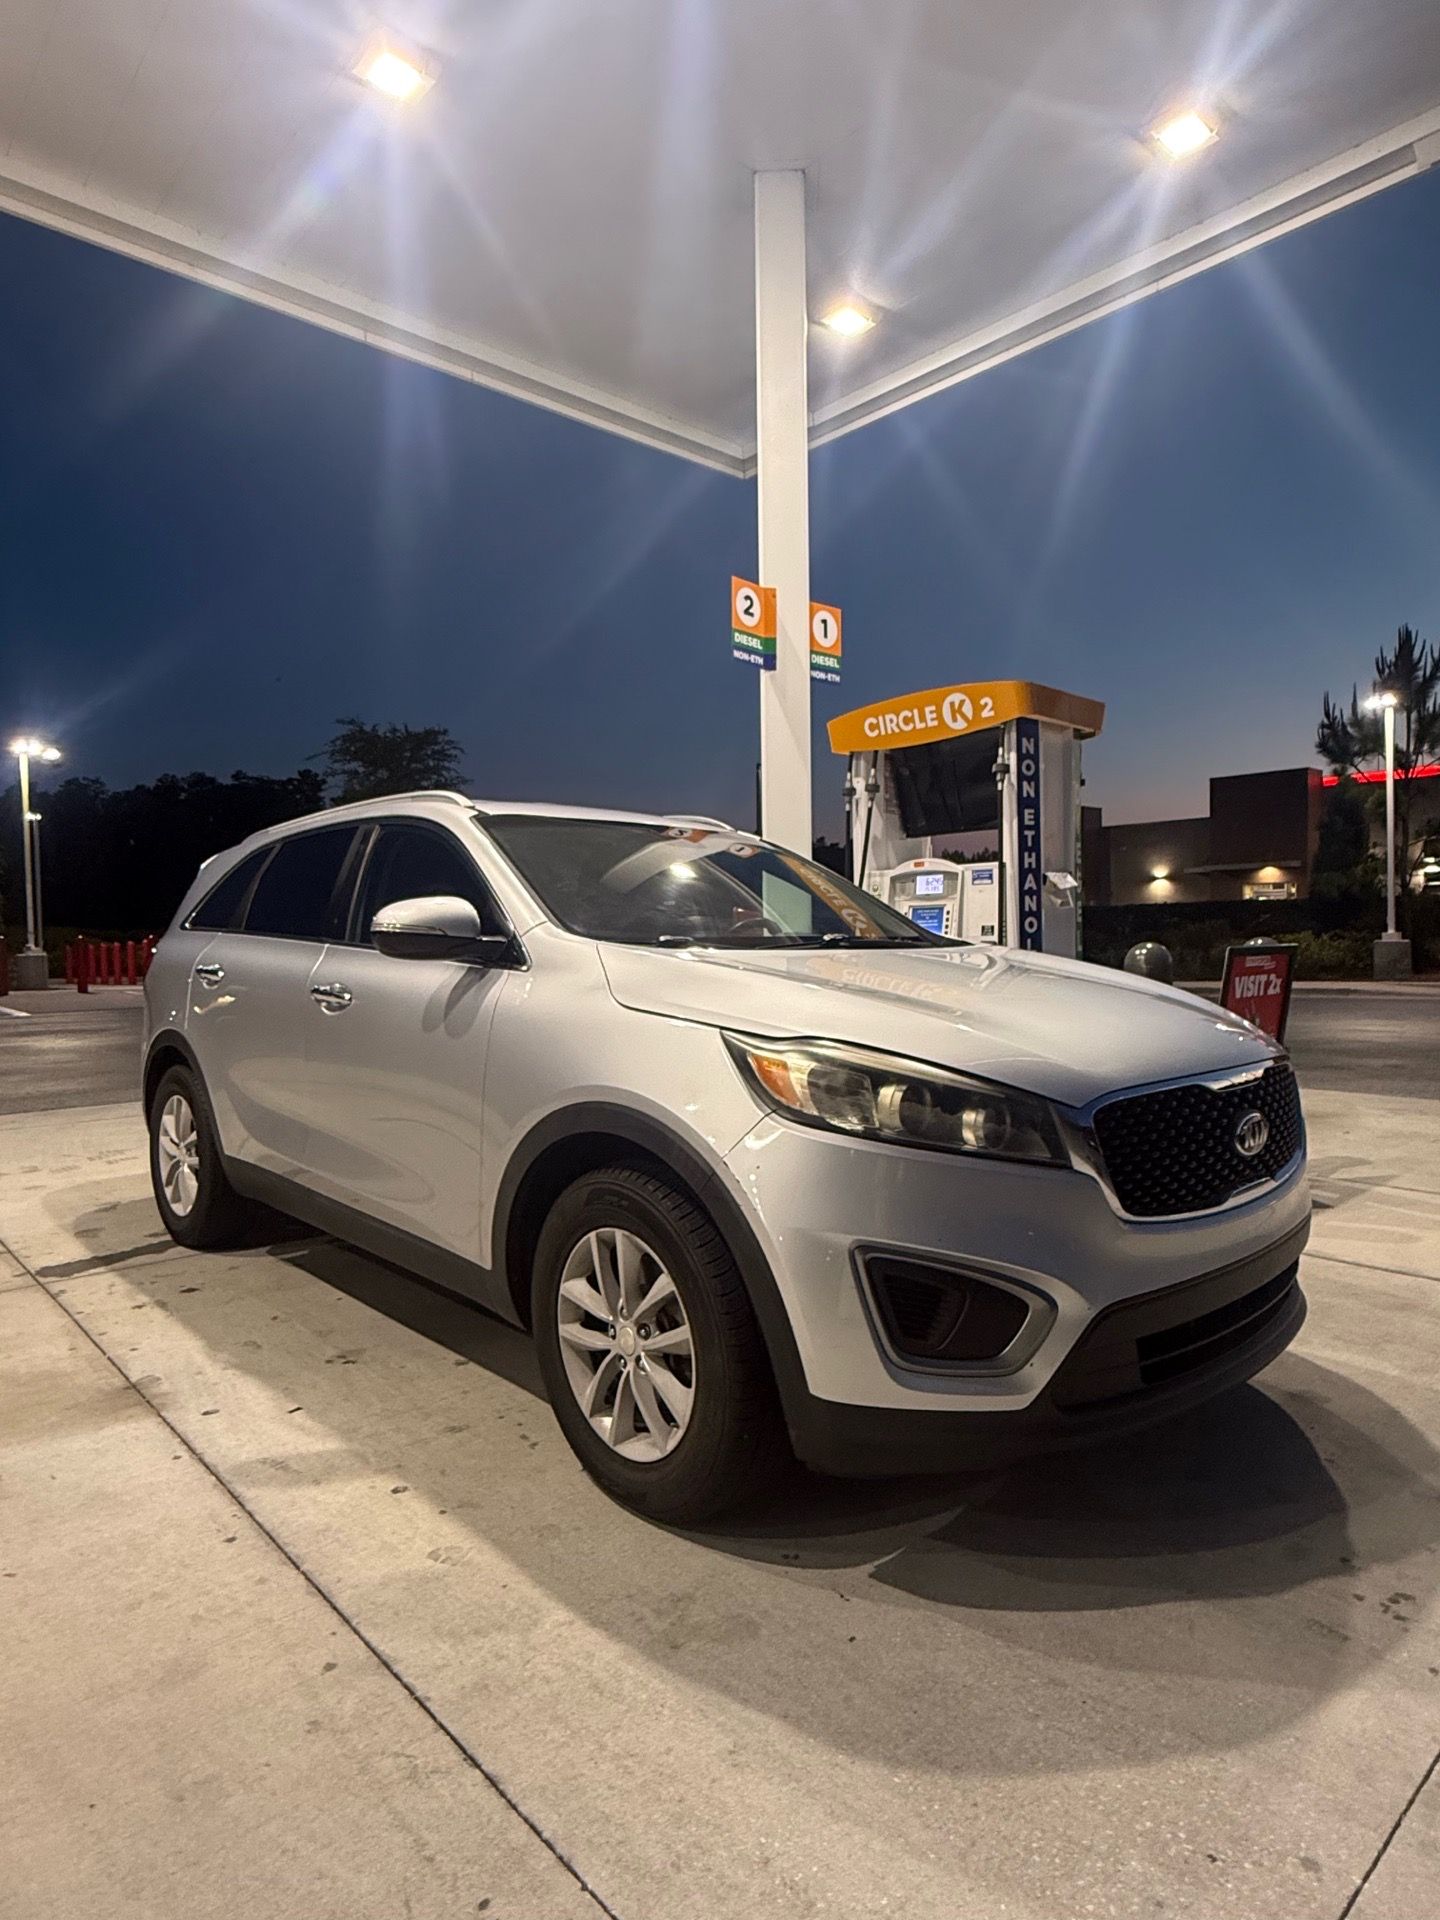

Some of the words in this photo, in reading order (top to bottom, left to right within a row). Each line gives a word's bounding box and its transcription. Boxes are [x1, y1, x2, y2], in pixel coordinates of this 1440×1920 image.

[743, 594, 755, 618] 2
[820, 619, 828, 639] 1
[734, 632, 763, 650] DIESEL
[733, 649, 764, 666] NON-ETH
[811, 653, 840, 669] DIESEL
[864, 705, 938, 738] CIRCLE
[944, 694, 972, 729] K
[979, 696, 995, 718] 2
[1022, 737, 1035, 798] NON
[1235, 974, 1268, 999] VISIT
